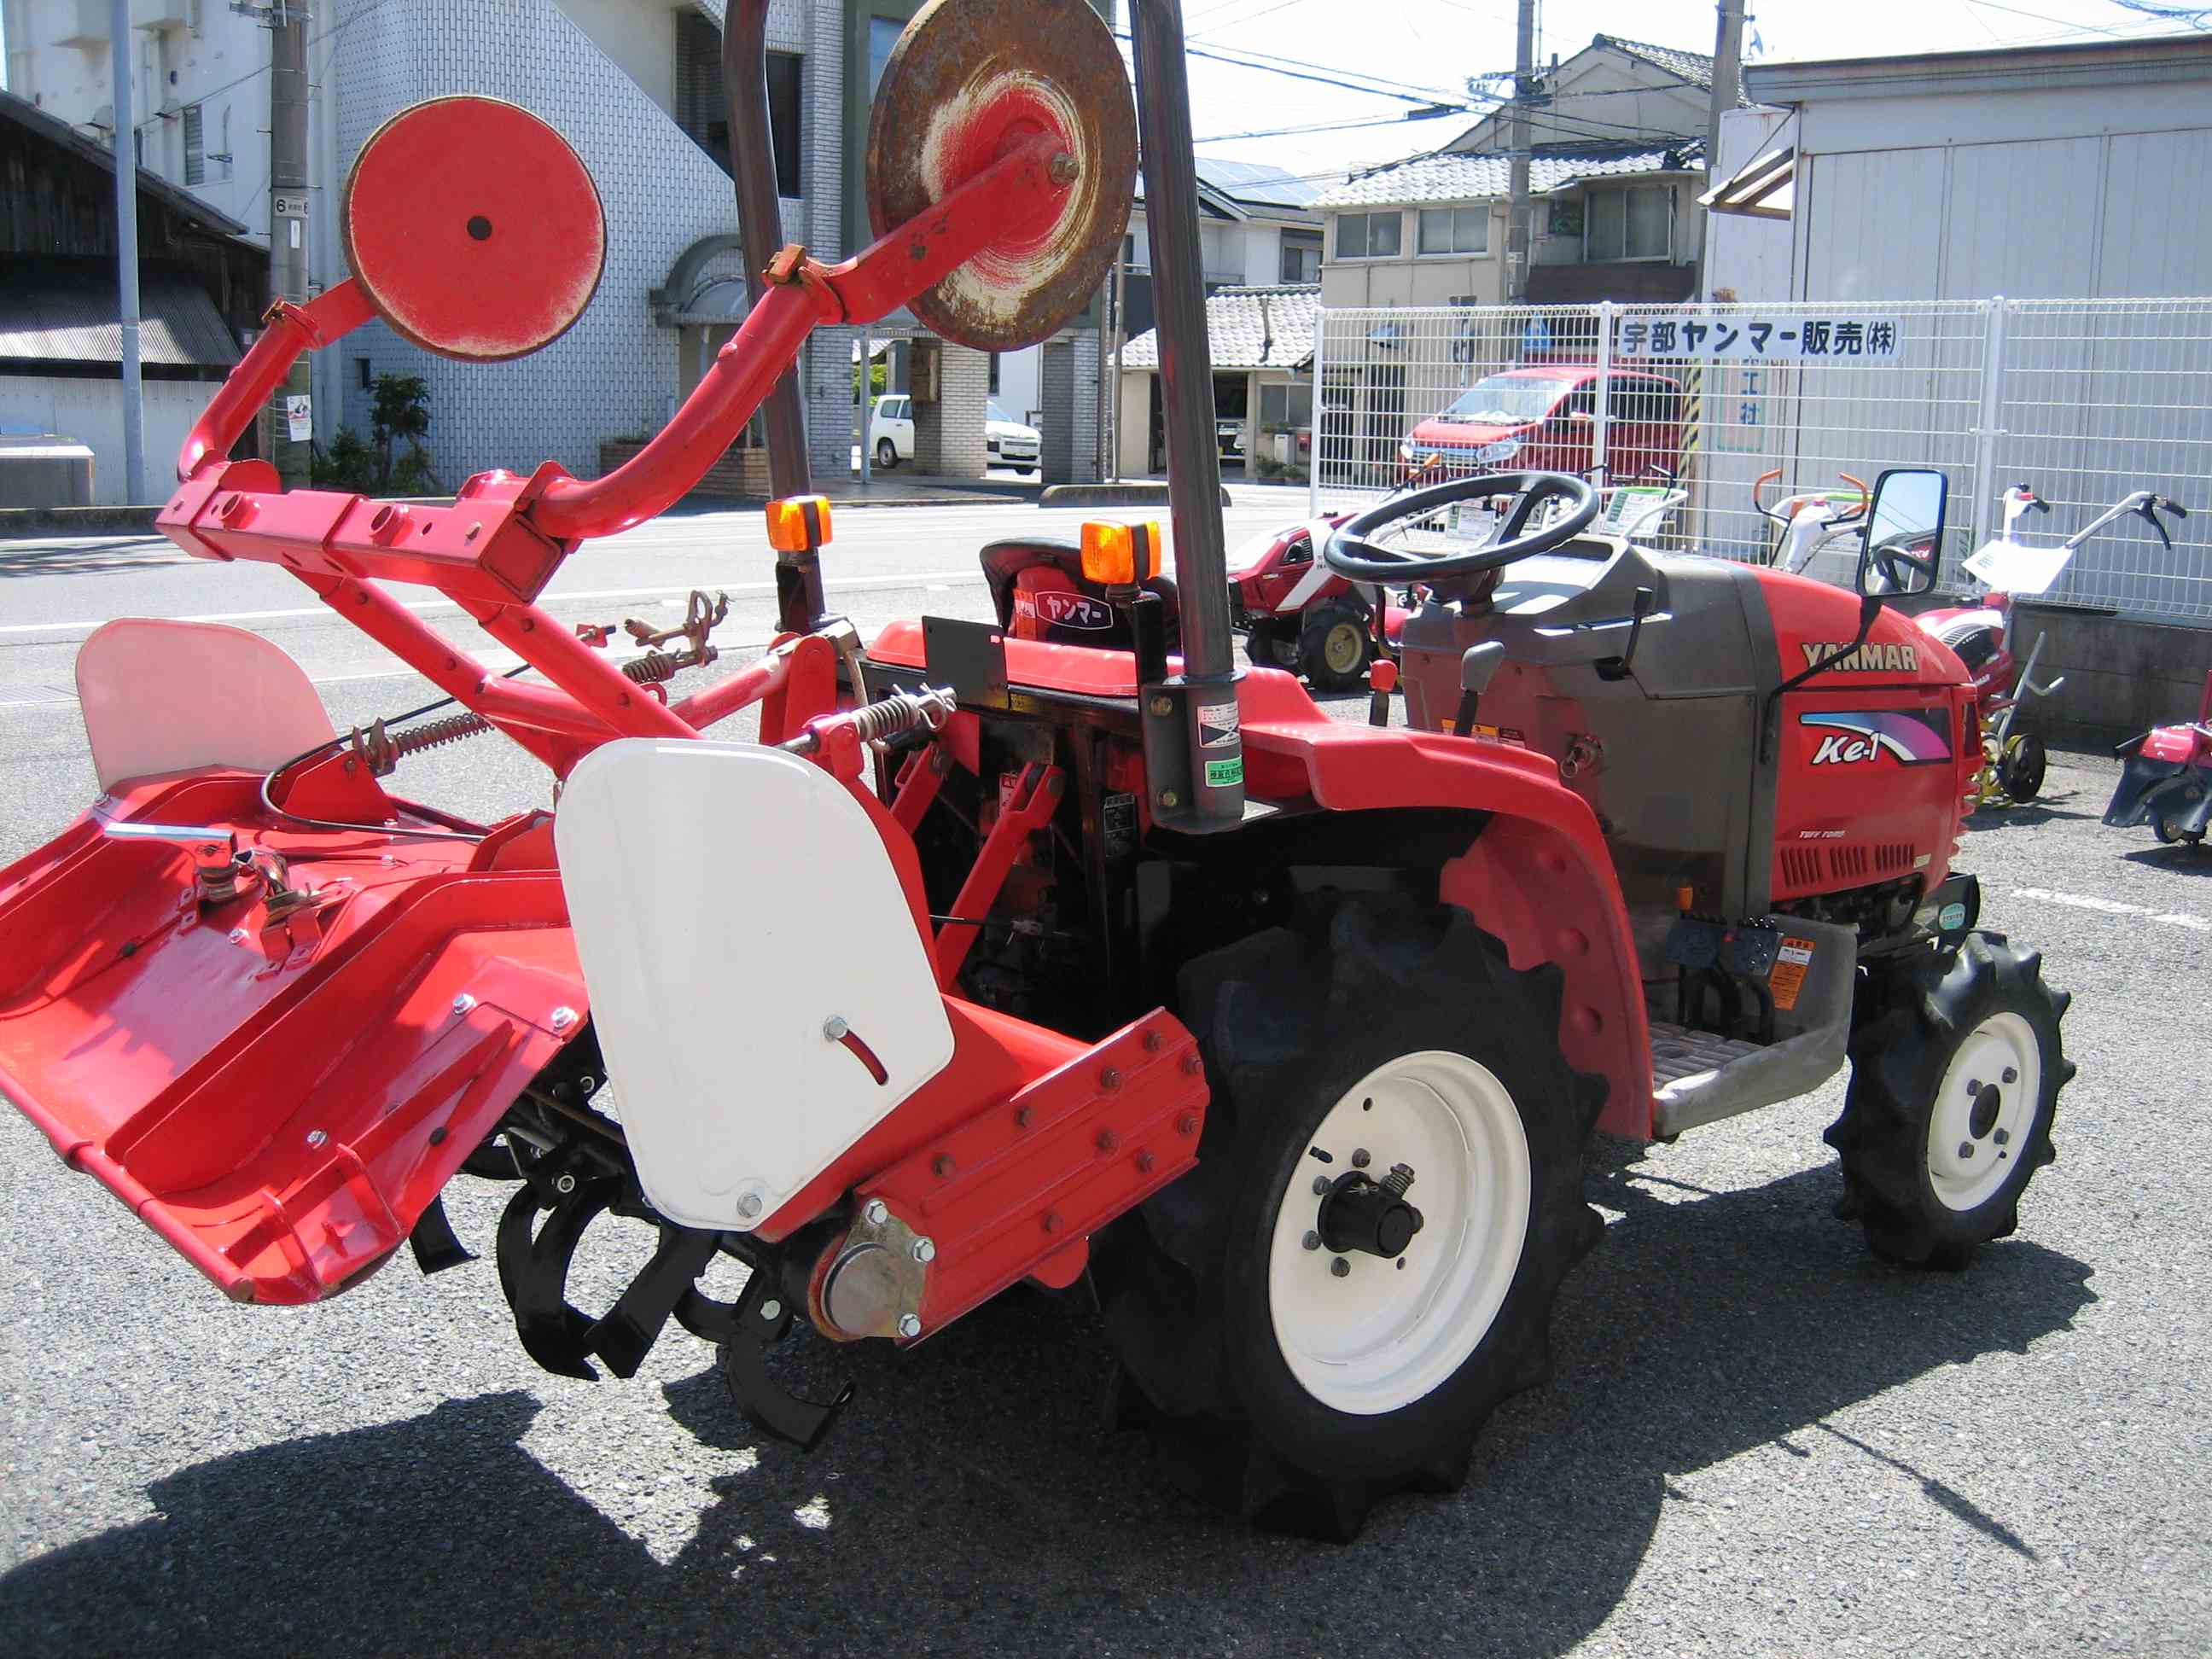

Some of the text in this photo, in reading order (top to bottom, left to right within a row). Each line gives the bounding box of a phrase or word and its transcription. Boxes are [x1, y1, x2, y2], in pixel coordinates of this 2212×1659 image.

[276, 199, 286, 212] 6
[1047, 596, 1102, 625] ヤンマー
[1802, 643, 1918, 672] YANMAR
